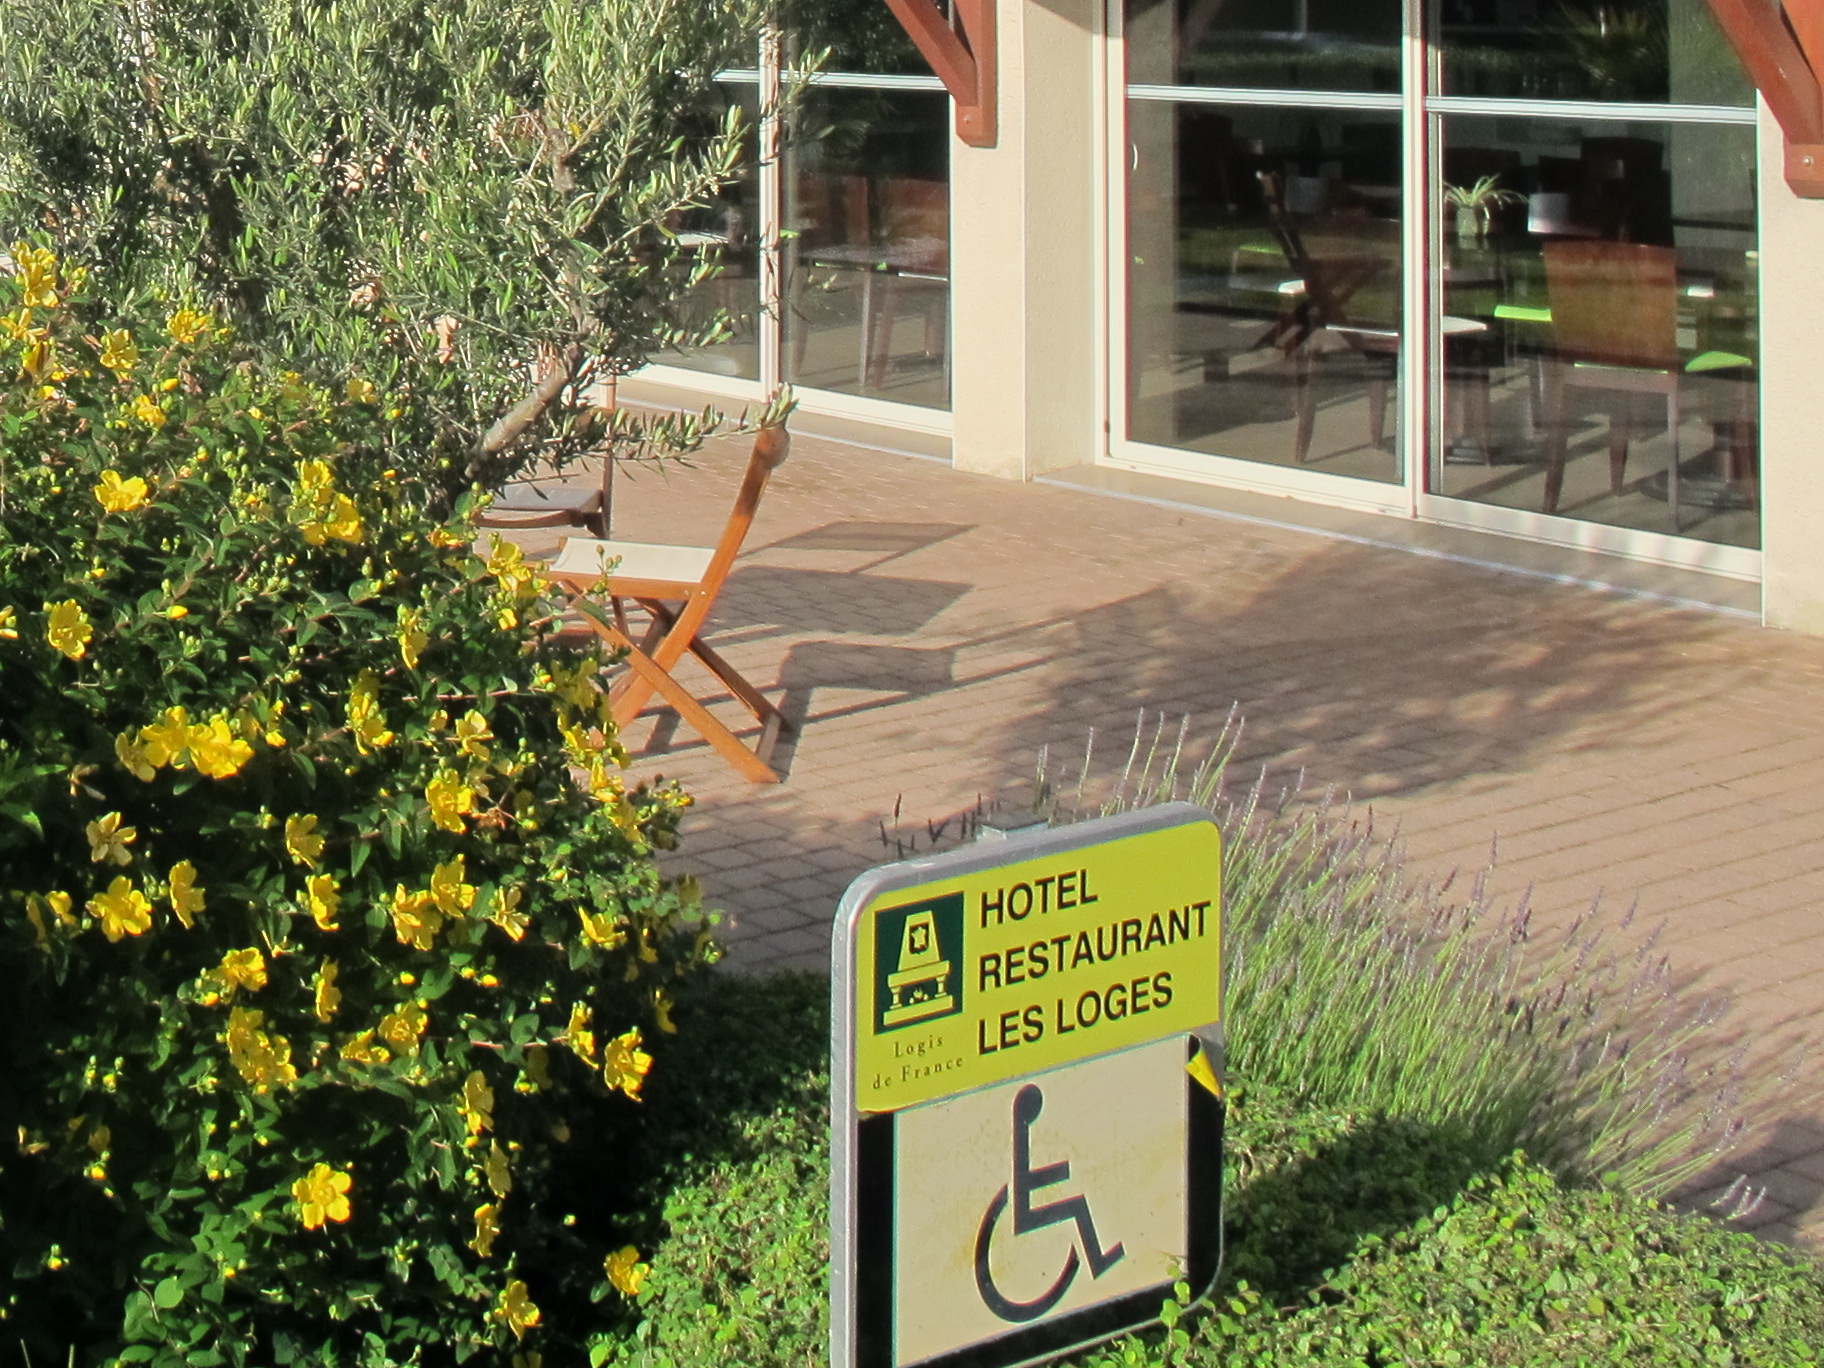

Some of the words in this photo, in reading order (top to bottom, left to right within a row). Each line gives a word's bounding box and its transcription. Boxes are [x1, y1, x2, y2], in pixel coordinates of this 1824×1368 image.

[979, 868, 1098, 929] HOTEL
[978, 900, 1211, 992] RESTAURANT
[978, 1005, 1044, 1056] LES
[1056, 972, 1173, 1036] LOGES
[872, 1073, 892, 1090] de
[901, 1056, 964, 1083] France
[894, 1034, 944, 1058] Logis
